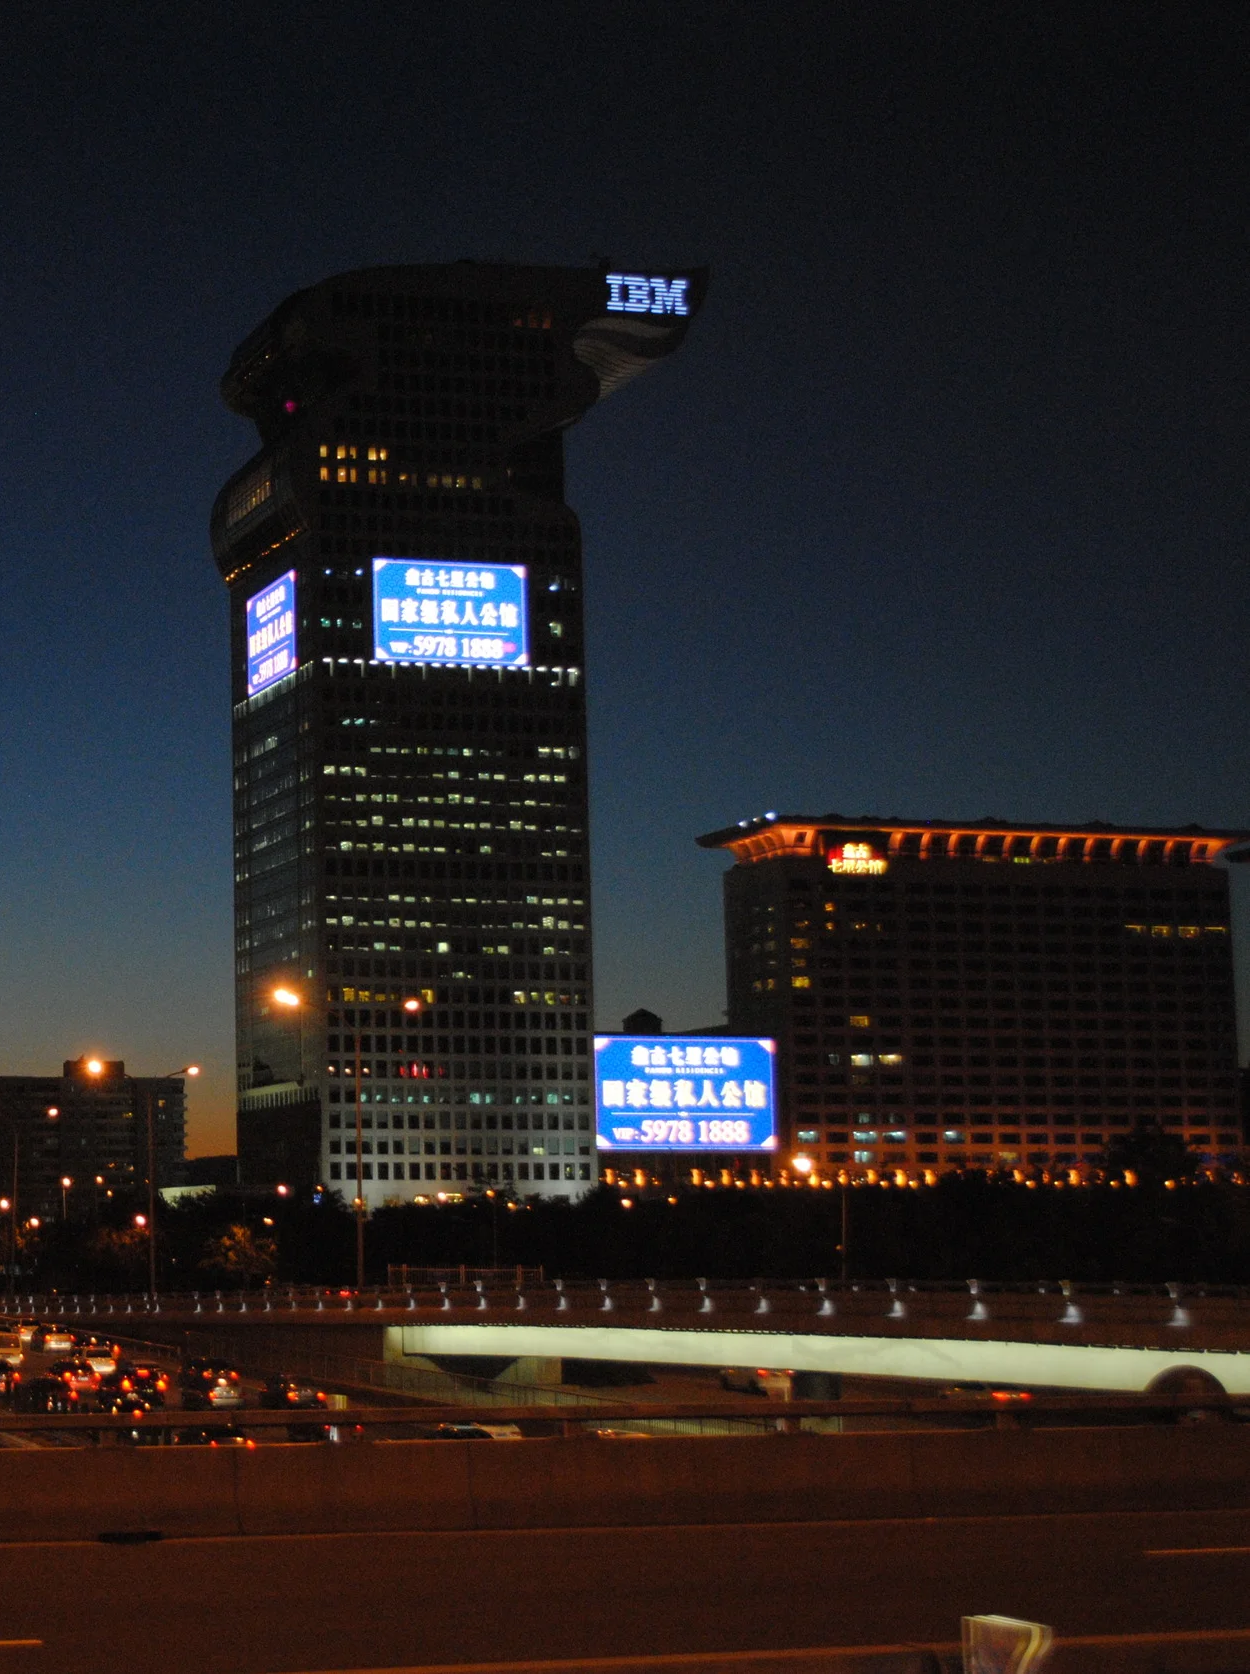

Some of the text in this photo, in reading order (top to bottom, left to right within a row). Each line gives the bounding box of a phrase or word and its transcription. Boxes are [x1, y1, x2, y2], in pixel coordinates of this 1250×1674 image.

[606, 275, 687, 315] IBM
[413, 636, 458, 657] 5978
[640, 1120, 694, 1143] 5978
[698, 1120, 750, 1143] 1888
